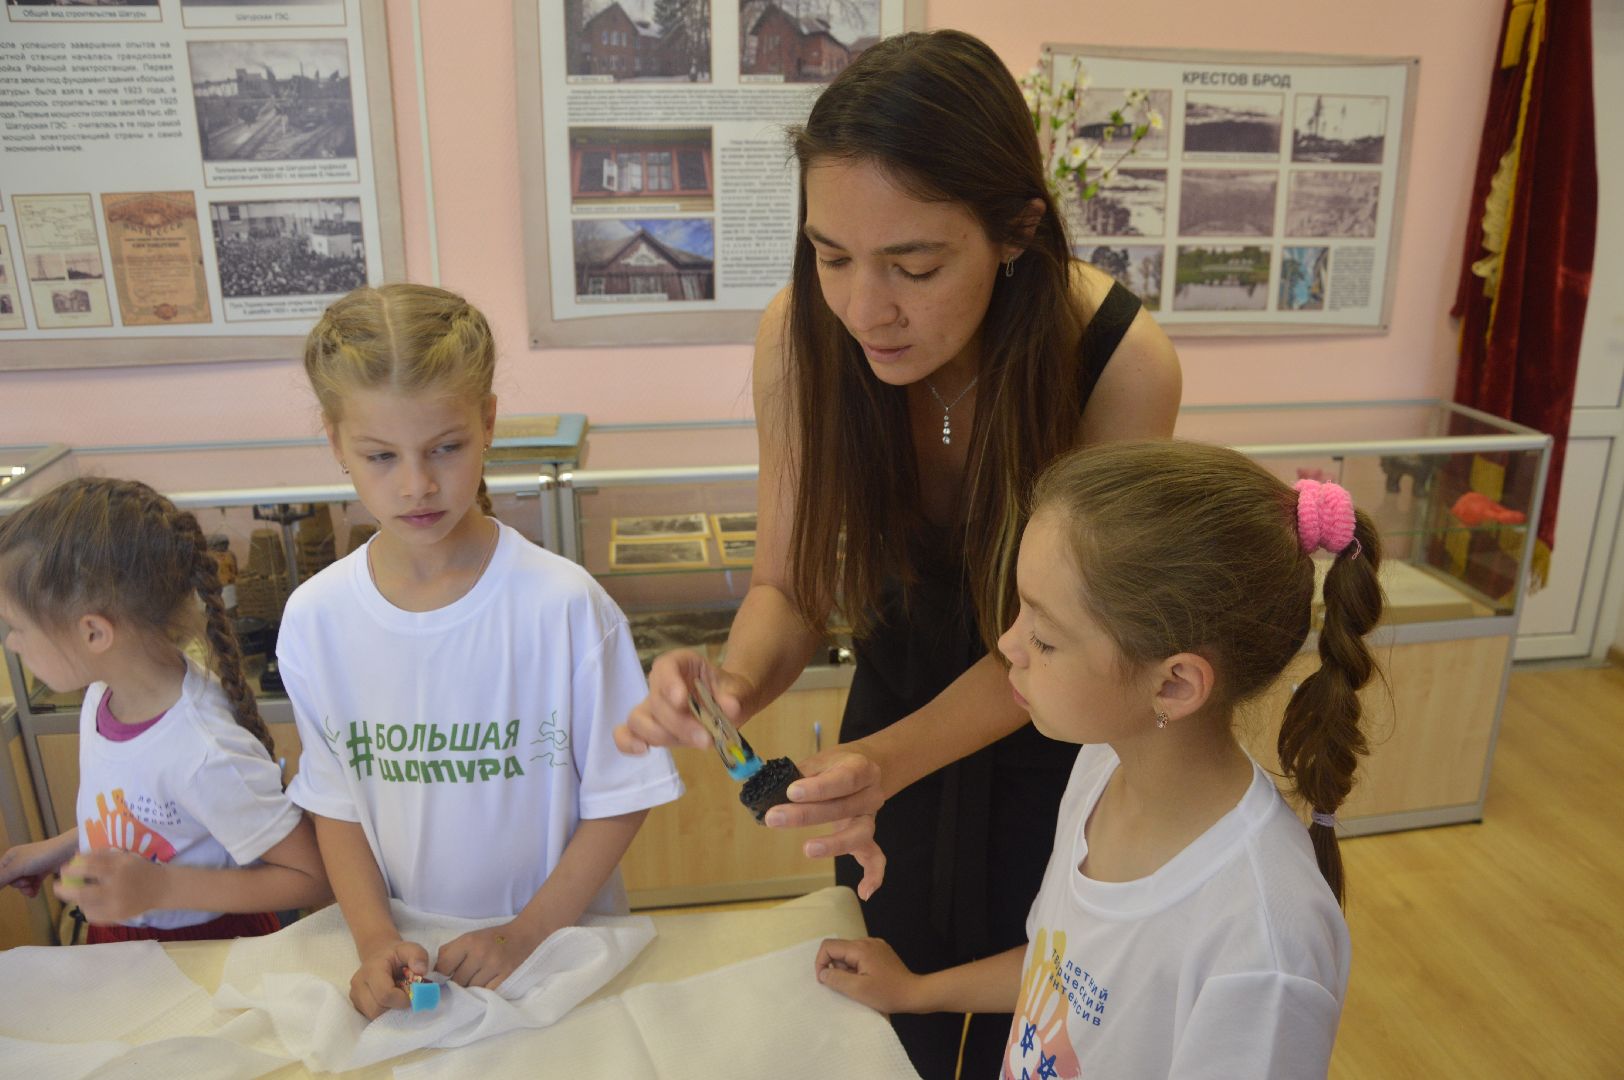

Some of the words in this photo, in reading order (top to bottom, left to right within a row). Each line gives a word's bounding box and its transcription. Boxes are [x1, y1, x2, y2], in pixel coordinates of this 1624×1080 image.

[1182, 71, 1249, 87] КРЕСТОВ
[1252, 73, 1292, 88] БРОД
[1066, 959, 1109, 1002] летний
